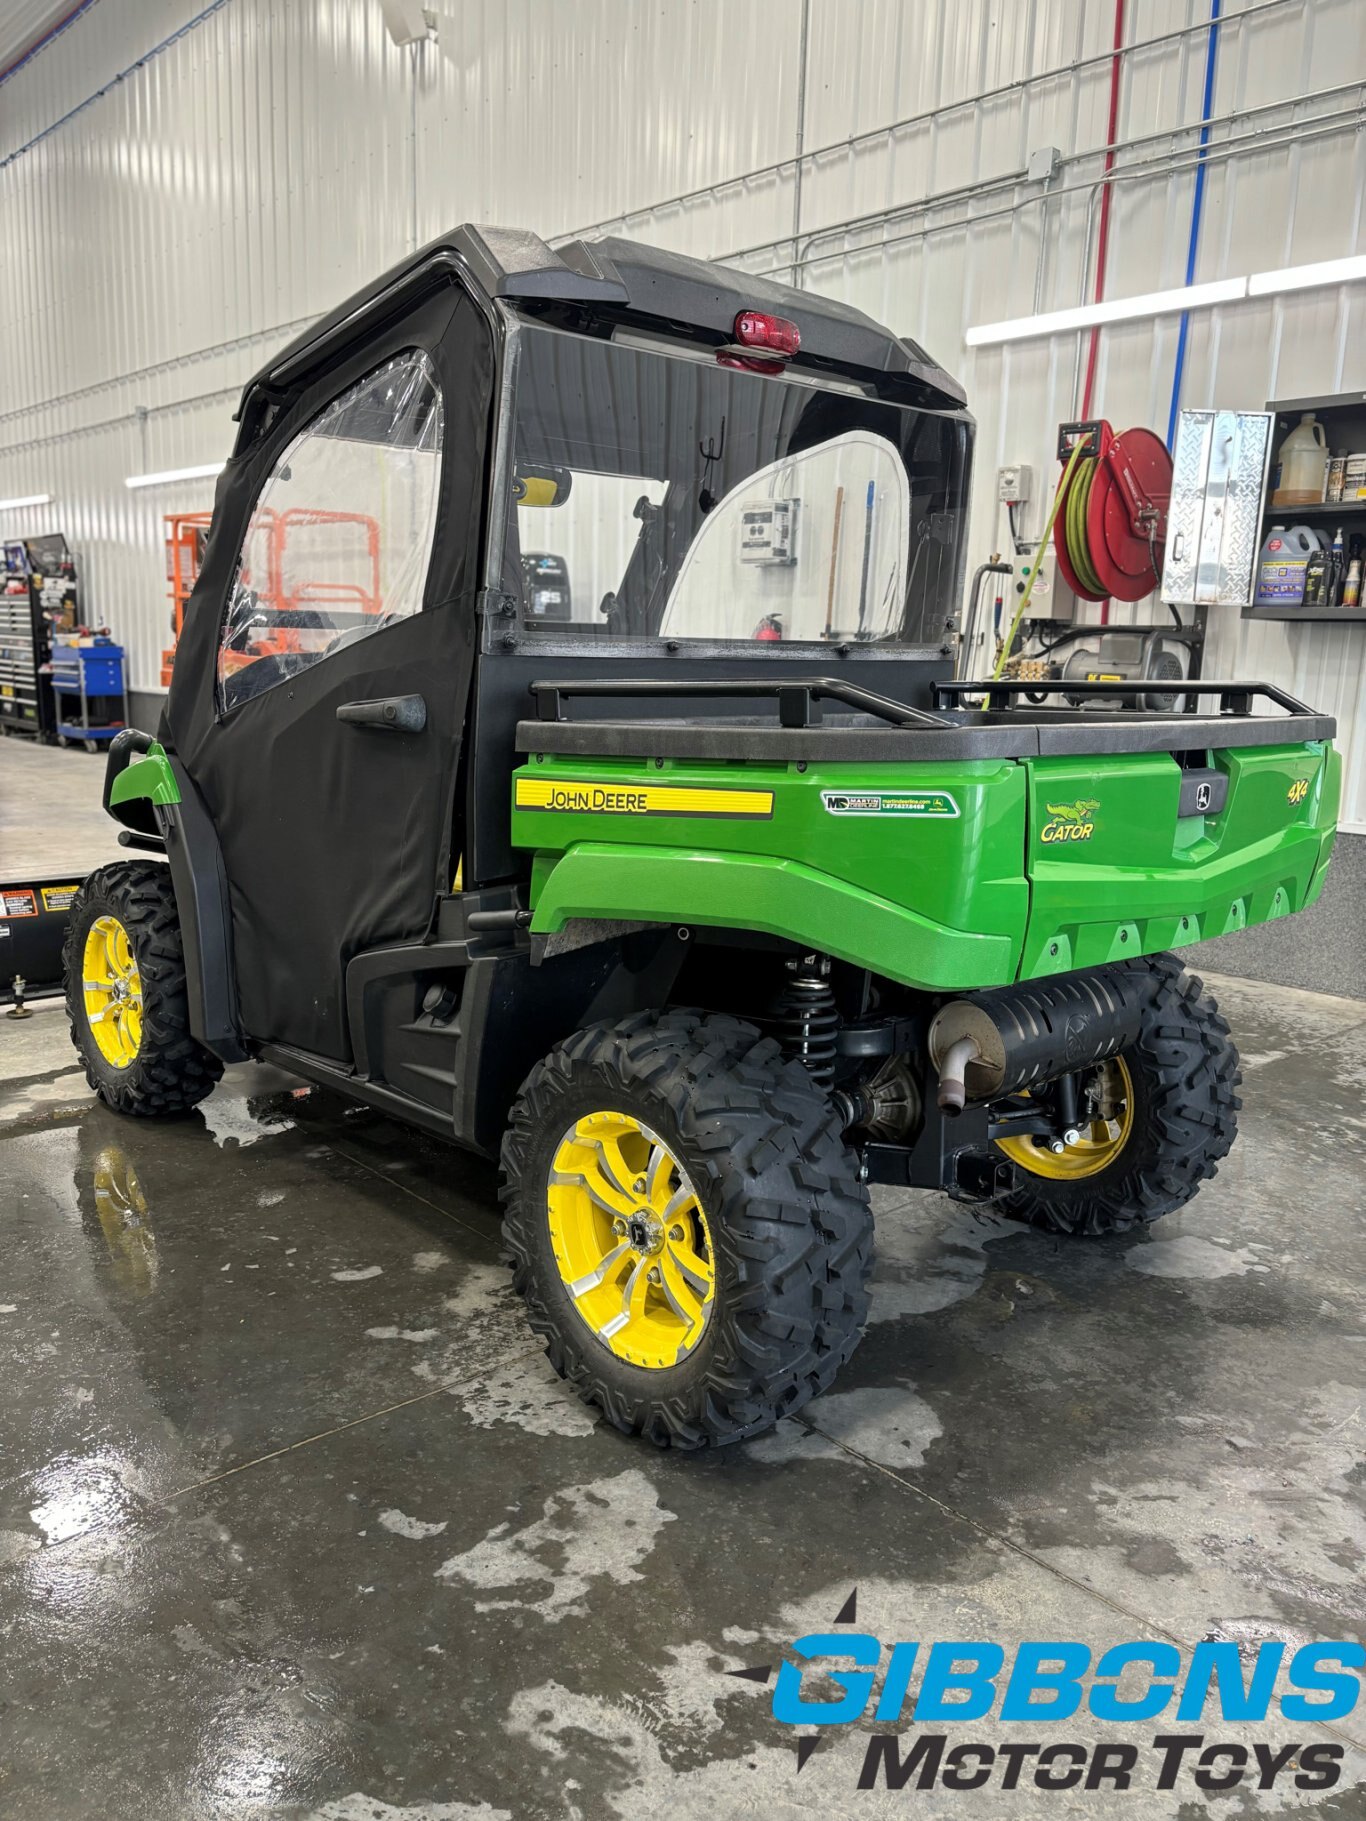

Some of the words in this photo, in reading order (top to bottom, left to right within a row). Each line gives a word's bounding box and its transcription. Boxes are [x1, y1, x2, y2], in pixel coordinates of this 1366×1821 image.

[546, 787, 589, 808] JOHN
[592, 789, 648, 810] DEERE
[1040, 823, 1094, 843] GATOR
